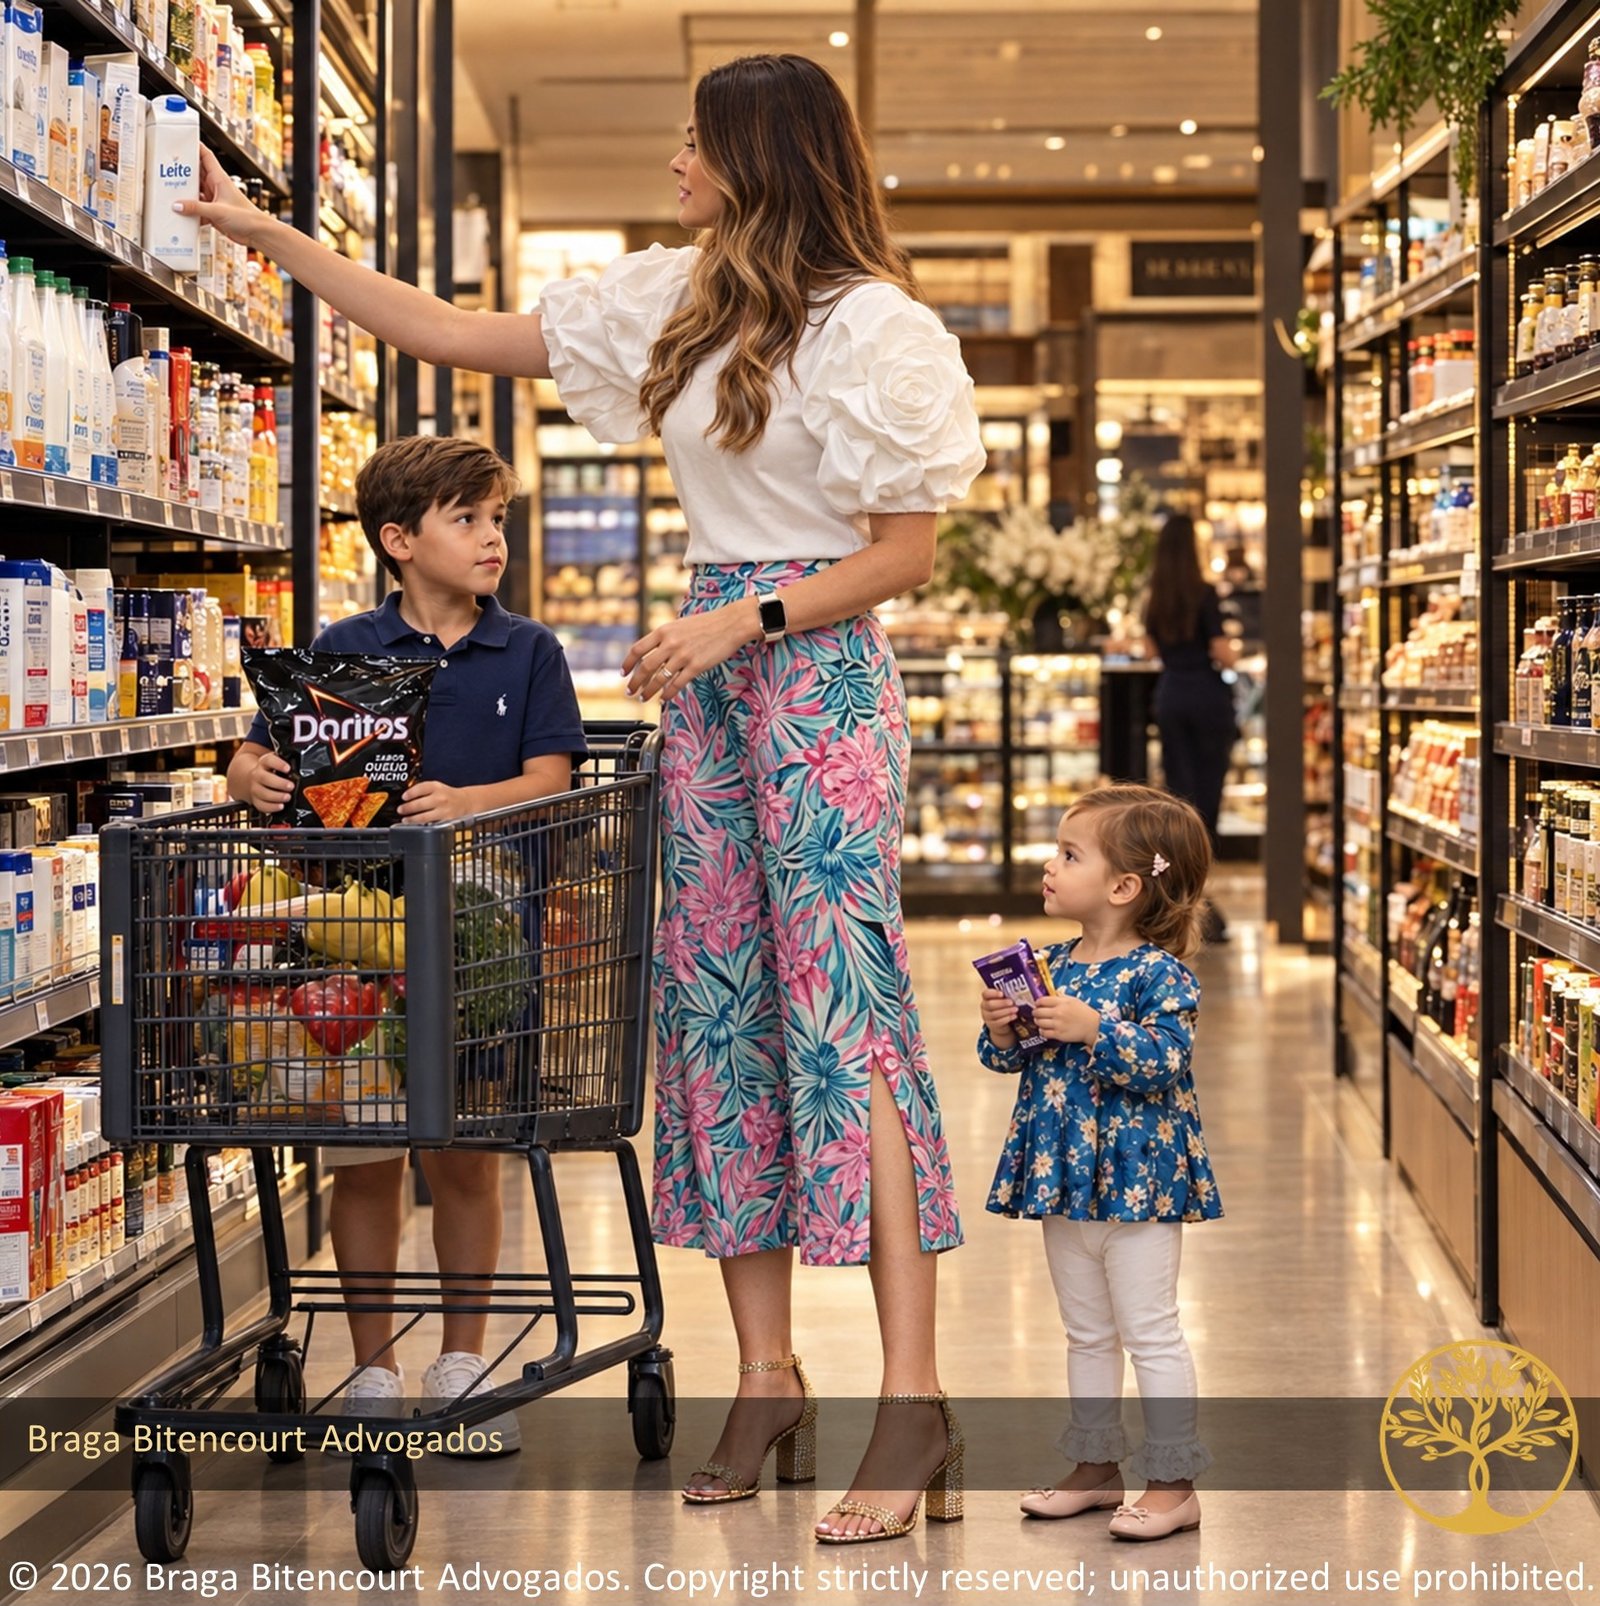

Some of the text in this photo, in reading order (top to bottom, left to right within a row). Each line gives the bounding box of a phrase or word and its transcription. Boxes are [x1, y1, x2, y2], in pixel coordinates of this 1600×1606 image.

[160, 162, 192, 178] Leite
[293, 714, 410, 743] Doritos
[368, 772, 409, 782] NACHO
